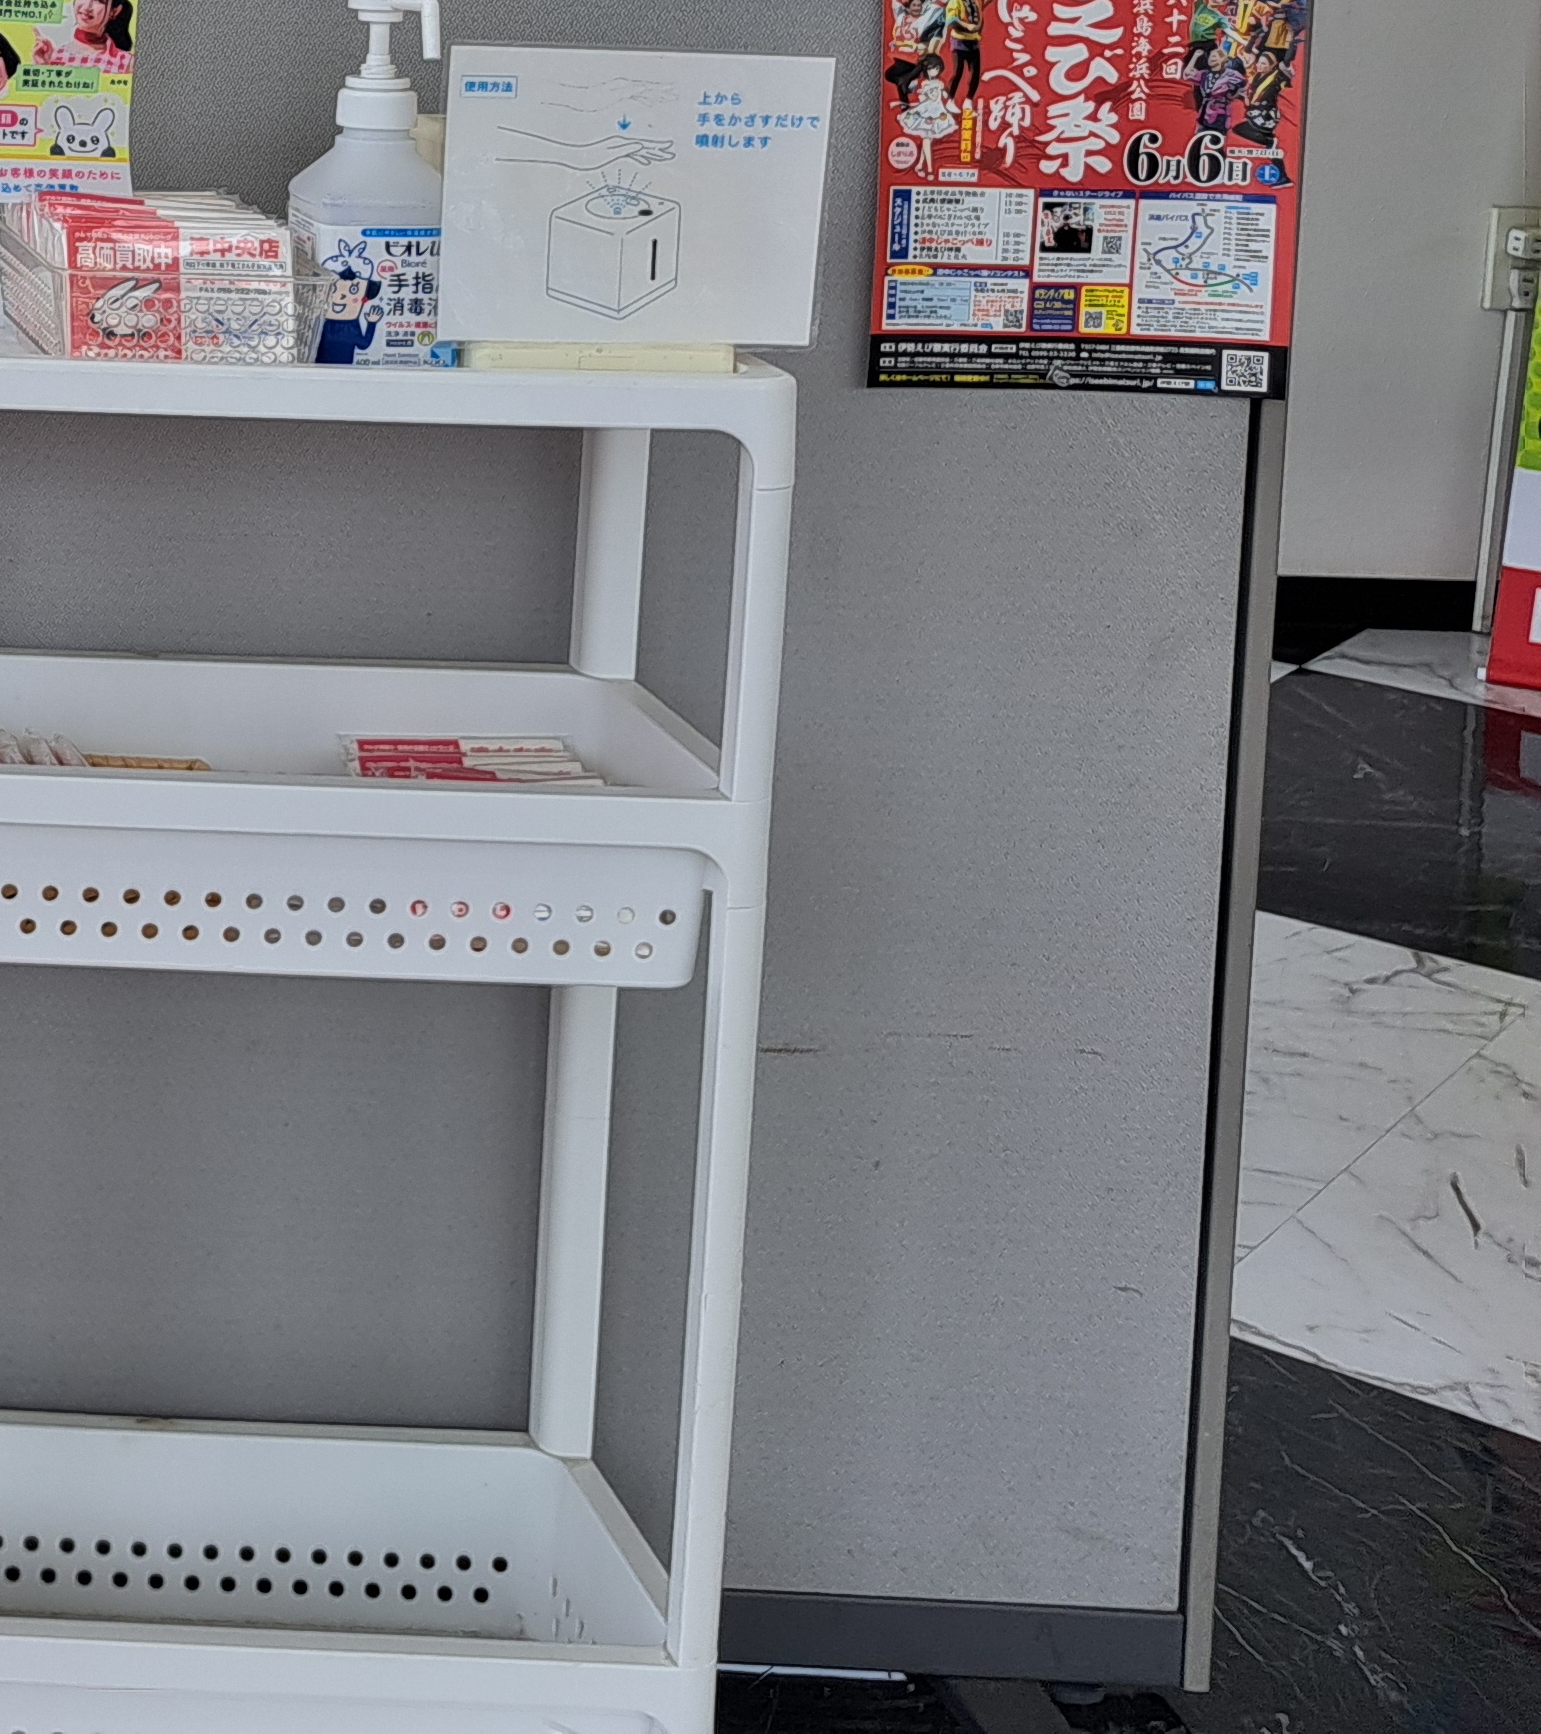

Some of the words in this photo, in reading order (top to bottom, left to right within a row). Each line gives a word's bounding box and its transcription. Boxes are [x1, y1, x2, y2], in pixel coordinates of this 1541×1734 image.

[465, 81, 513, 93] 使用方法
[698, 92, 742, 105] 上から
[696, 113, 819, 128] 手をかざすだけで
[695, 134, 771, 149] 噴射します
[76, 242, 173, 270] 高価買取中
[189, 238, 280, 259] 津中央店
[401, 259, 427, 268] Bioré
